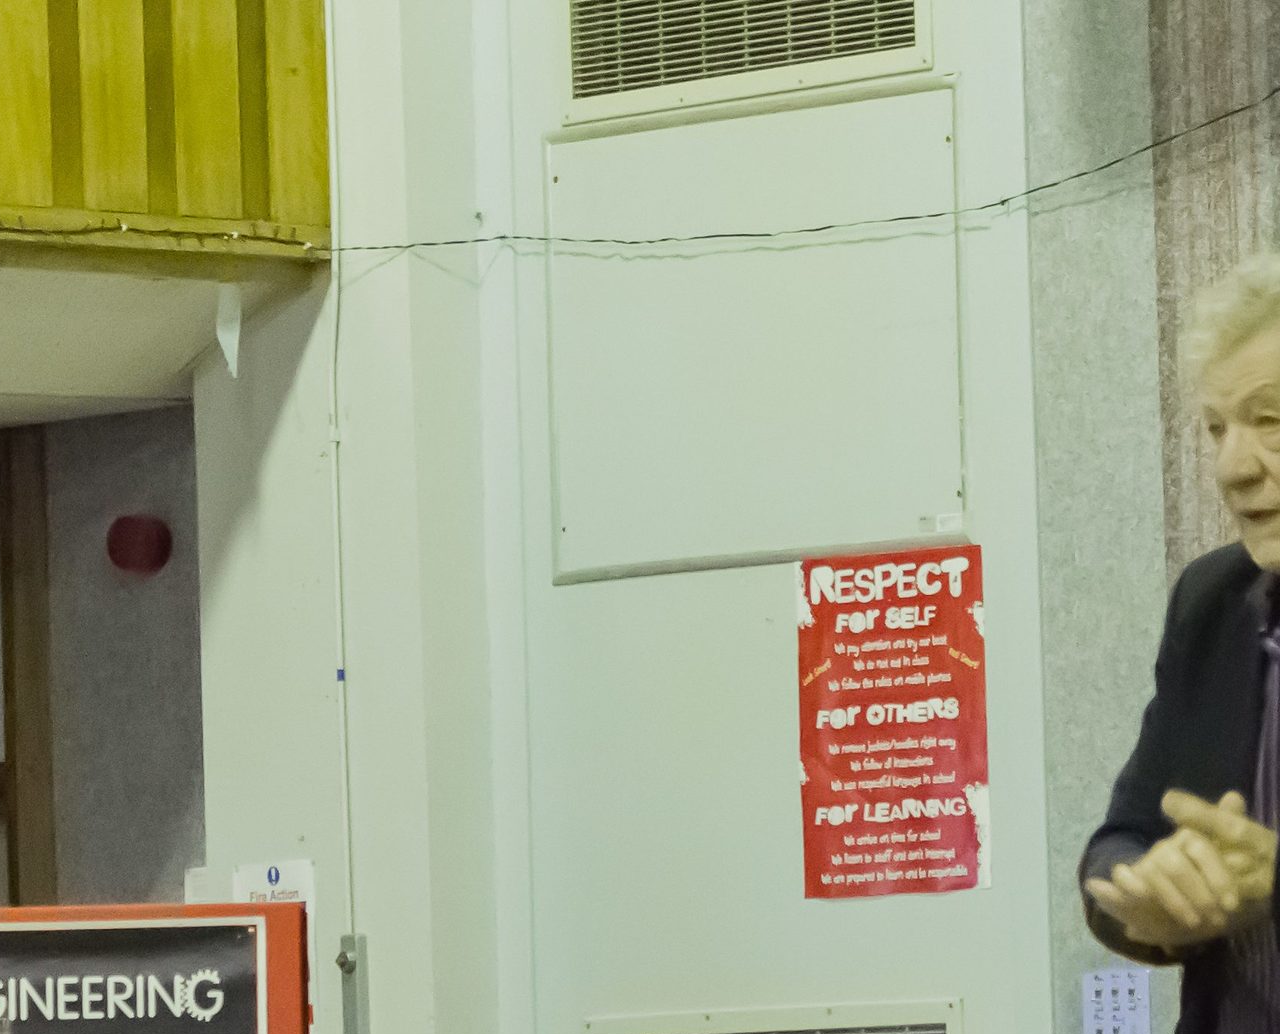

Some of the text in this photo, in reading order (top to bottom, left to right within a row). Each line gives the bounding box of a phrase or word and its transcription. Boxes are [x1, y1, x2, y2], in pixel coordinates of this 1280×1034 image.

[809, 557, 970, 605] RESPECT
[884, 605, 937, 630] SELF
[866, 696, 960, 726] OTHERS
[863, 796, 967, 823] LEARNING
[249, 888, 300, 903] Fire Action
